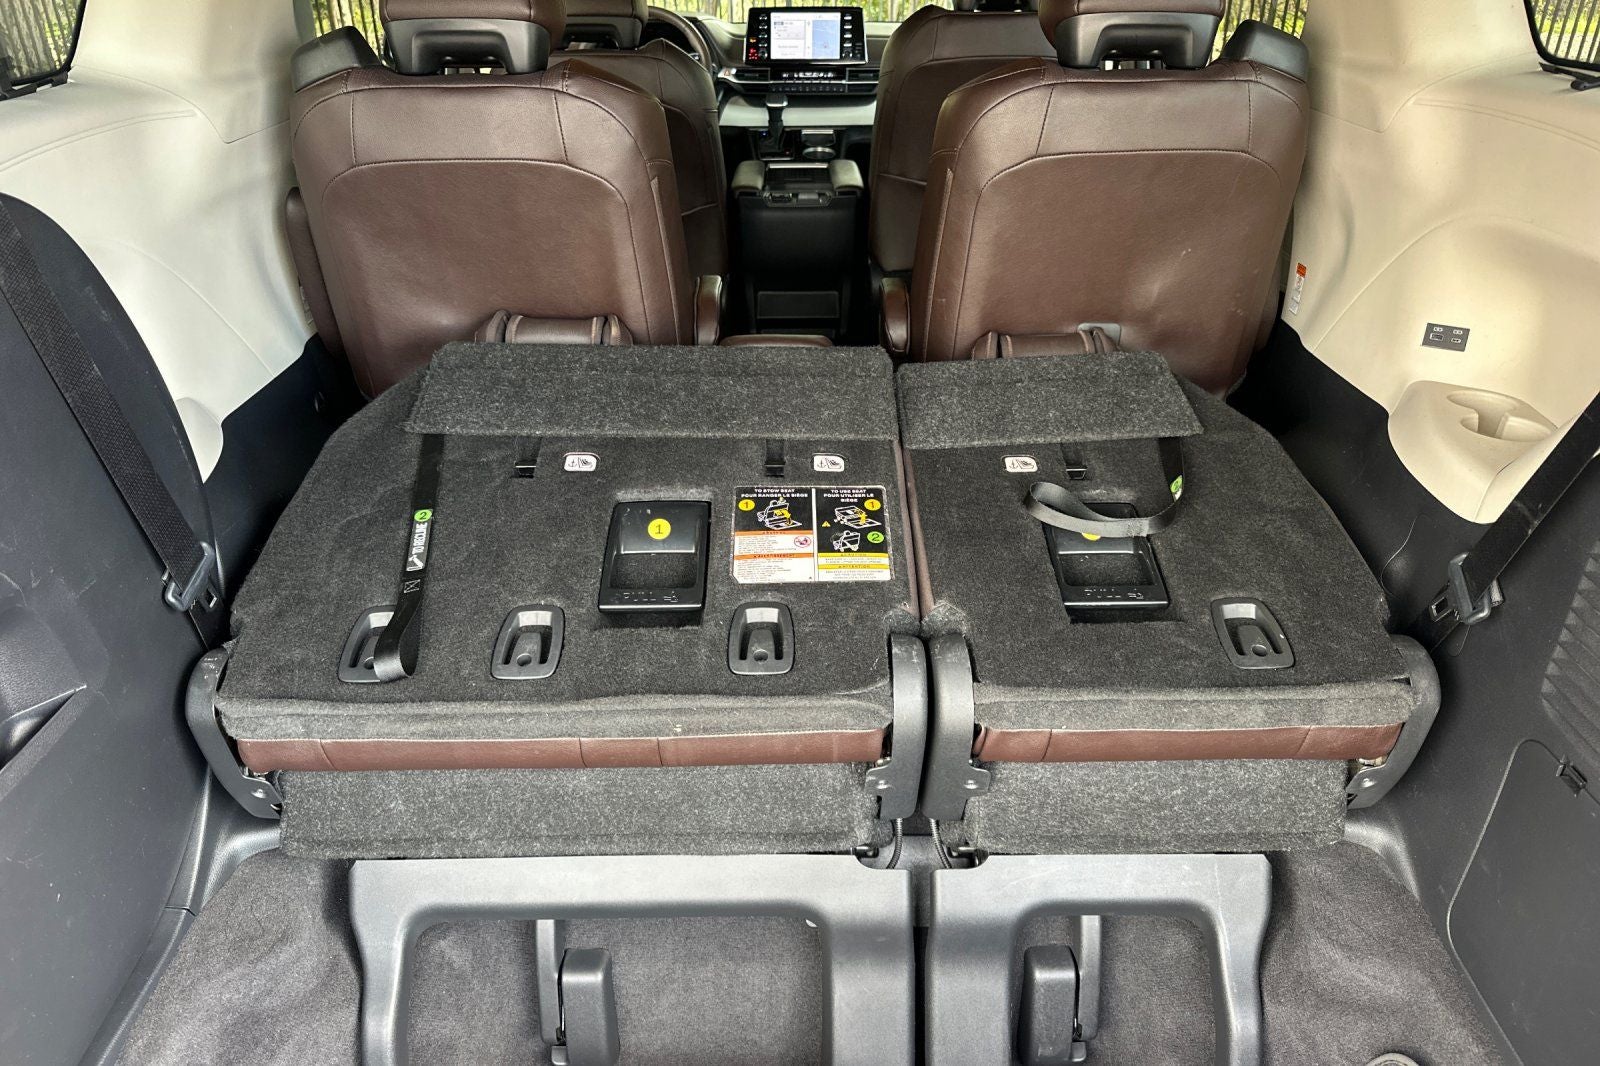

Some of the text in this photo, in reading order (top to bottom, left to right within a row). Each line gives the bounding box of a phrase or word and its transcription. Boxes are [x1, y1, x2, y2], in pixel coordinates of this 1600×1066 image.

[419, 512, 427, 520] 2
[655, 524, 663, 535] 1
[872, 533, 880, 541] 2
